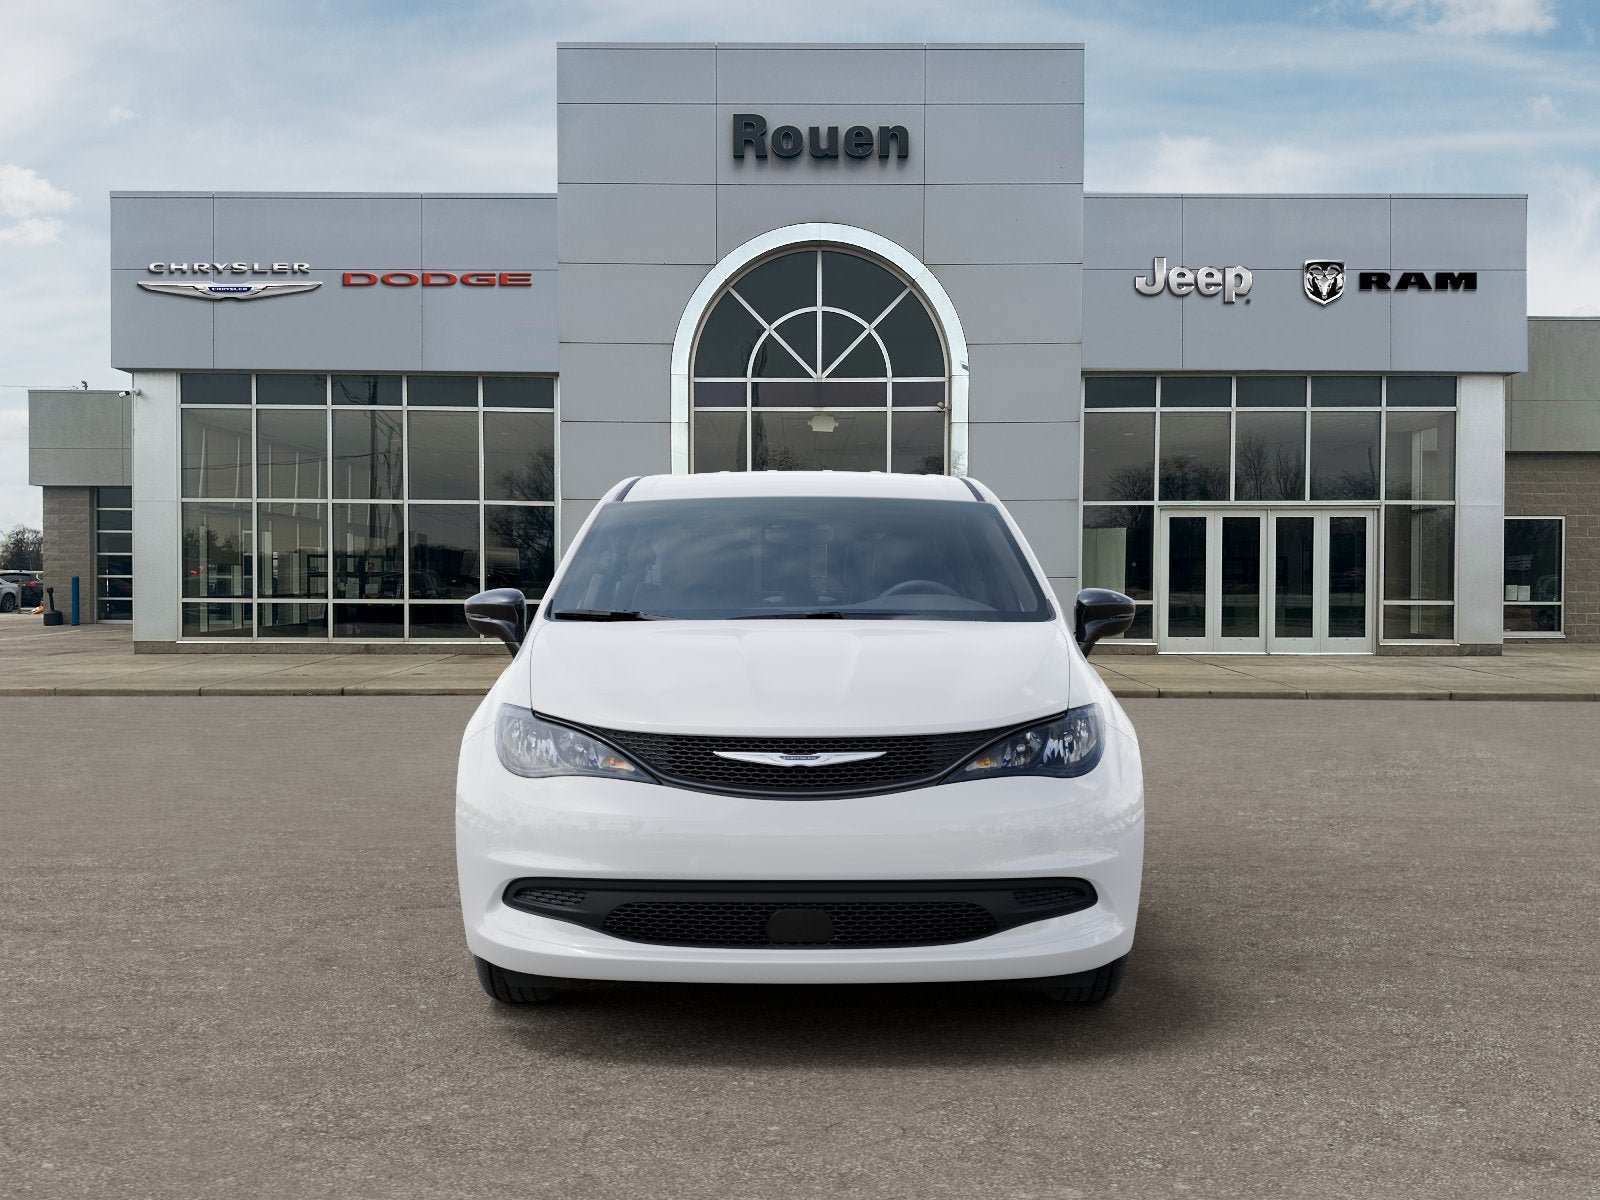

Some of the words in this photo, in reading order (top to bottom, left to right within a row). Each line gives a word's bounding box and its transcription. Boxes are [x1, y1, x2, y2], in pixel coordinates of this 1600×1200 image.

[733, 113, 909, 159] Rouen
[148, 262, 311, 274] CHRYSLER
[341, 271, 533, 288] DODGE
[1135, 256, 1253, 304] Jeep
[1359, 271, 1478, 291] RAM
